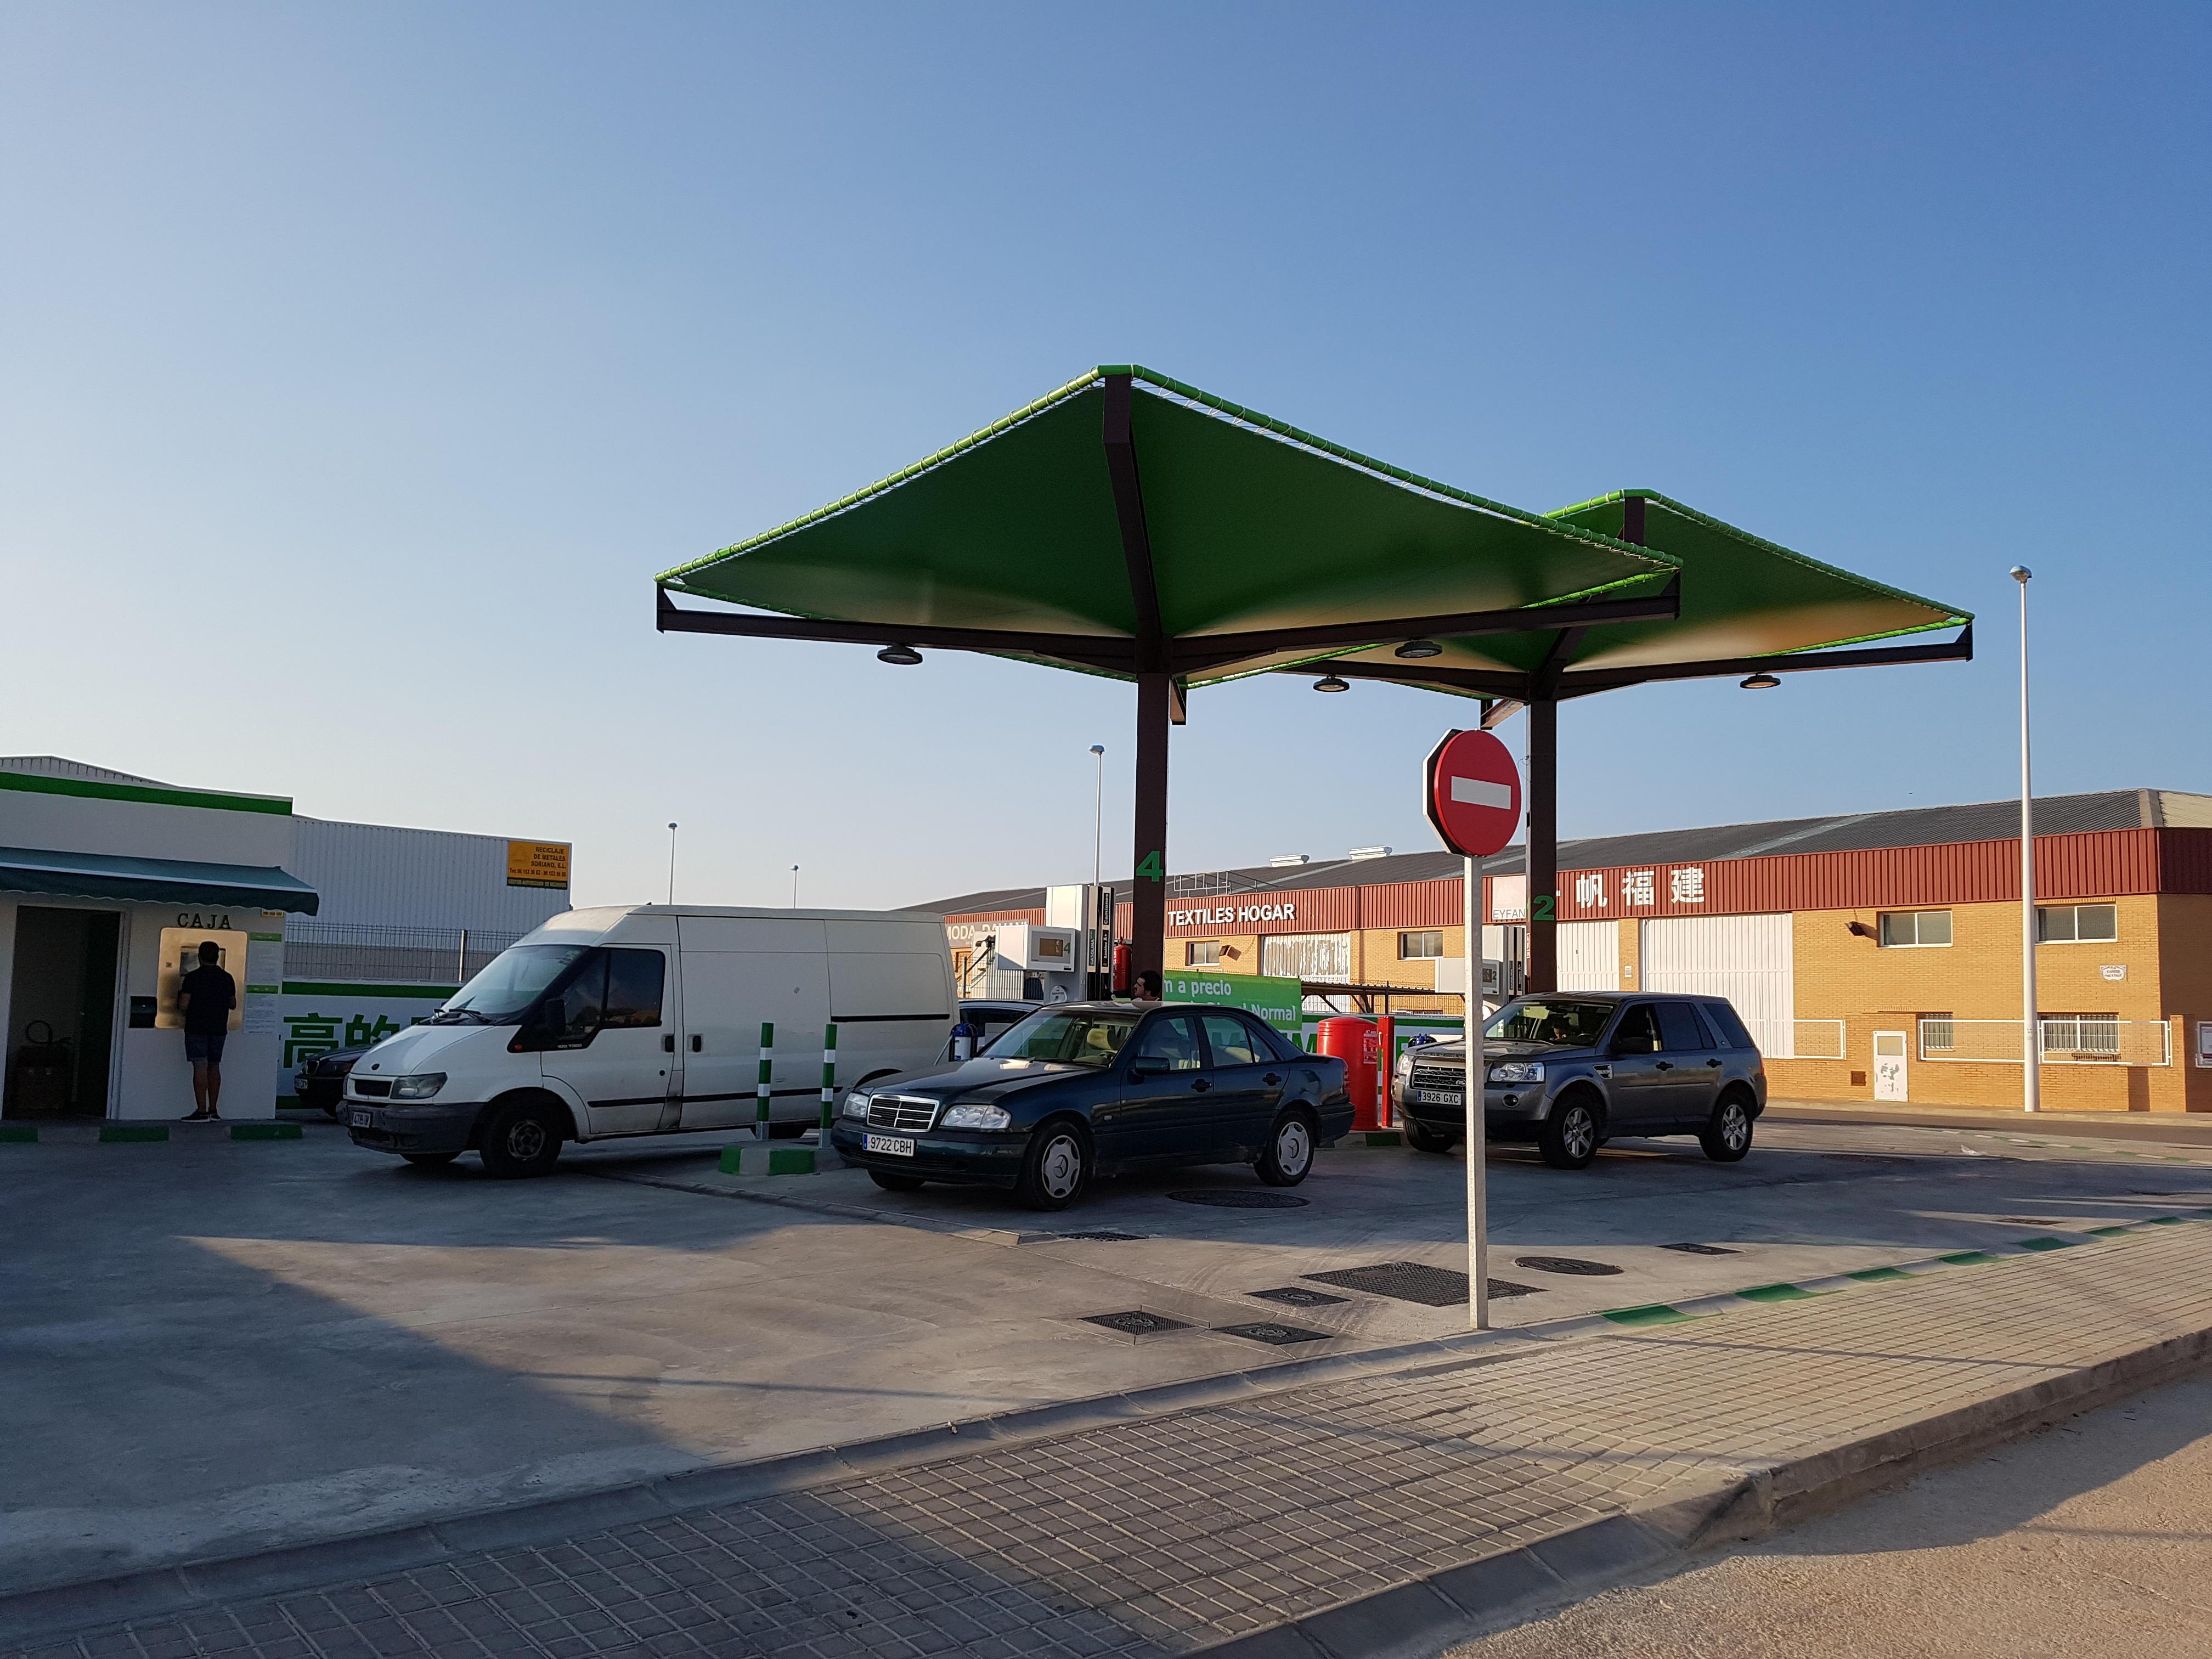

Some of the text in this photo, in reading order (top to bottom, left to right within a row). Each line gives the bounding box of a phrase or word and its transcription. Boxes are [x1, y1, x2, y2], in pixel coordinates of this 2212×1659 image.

[1136, 850, 1164, 882] 4
[1556, 867, 1705, 909] 帆福建
[1167, 903, 1296, 927] TEXTILES HOGAR
[1493, 909, 1526, 919] EYFAN
[1532, 895, 1555, 921] 2
[177, 912, 232, 929] CAJA
[1492, 971, 1497, 980] 2
[1178, 980, 1186, 994] a
[1191, 979, 1232, 997] precio
[1251, 1003, 1296, 1022] Normal
[1422, 1092, 1459, 1104] 3926 GXC
[871, 1137, 912, 1154] 9722 CBH
